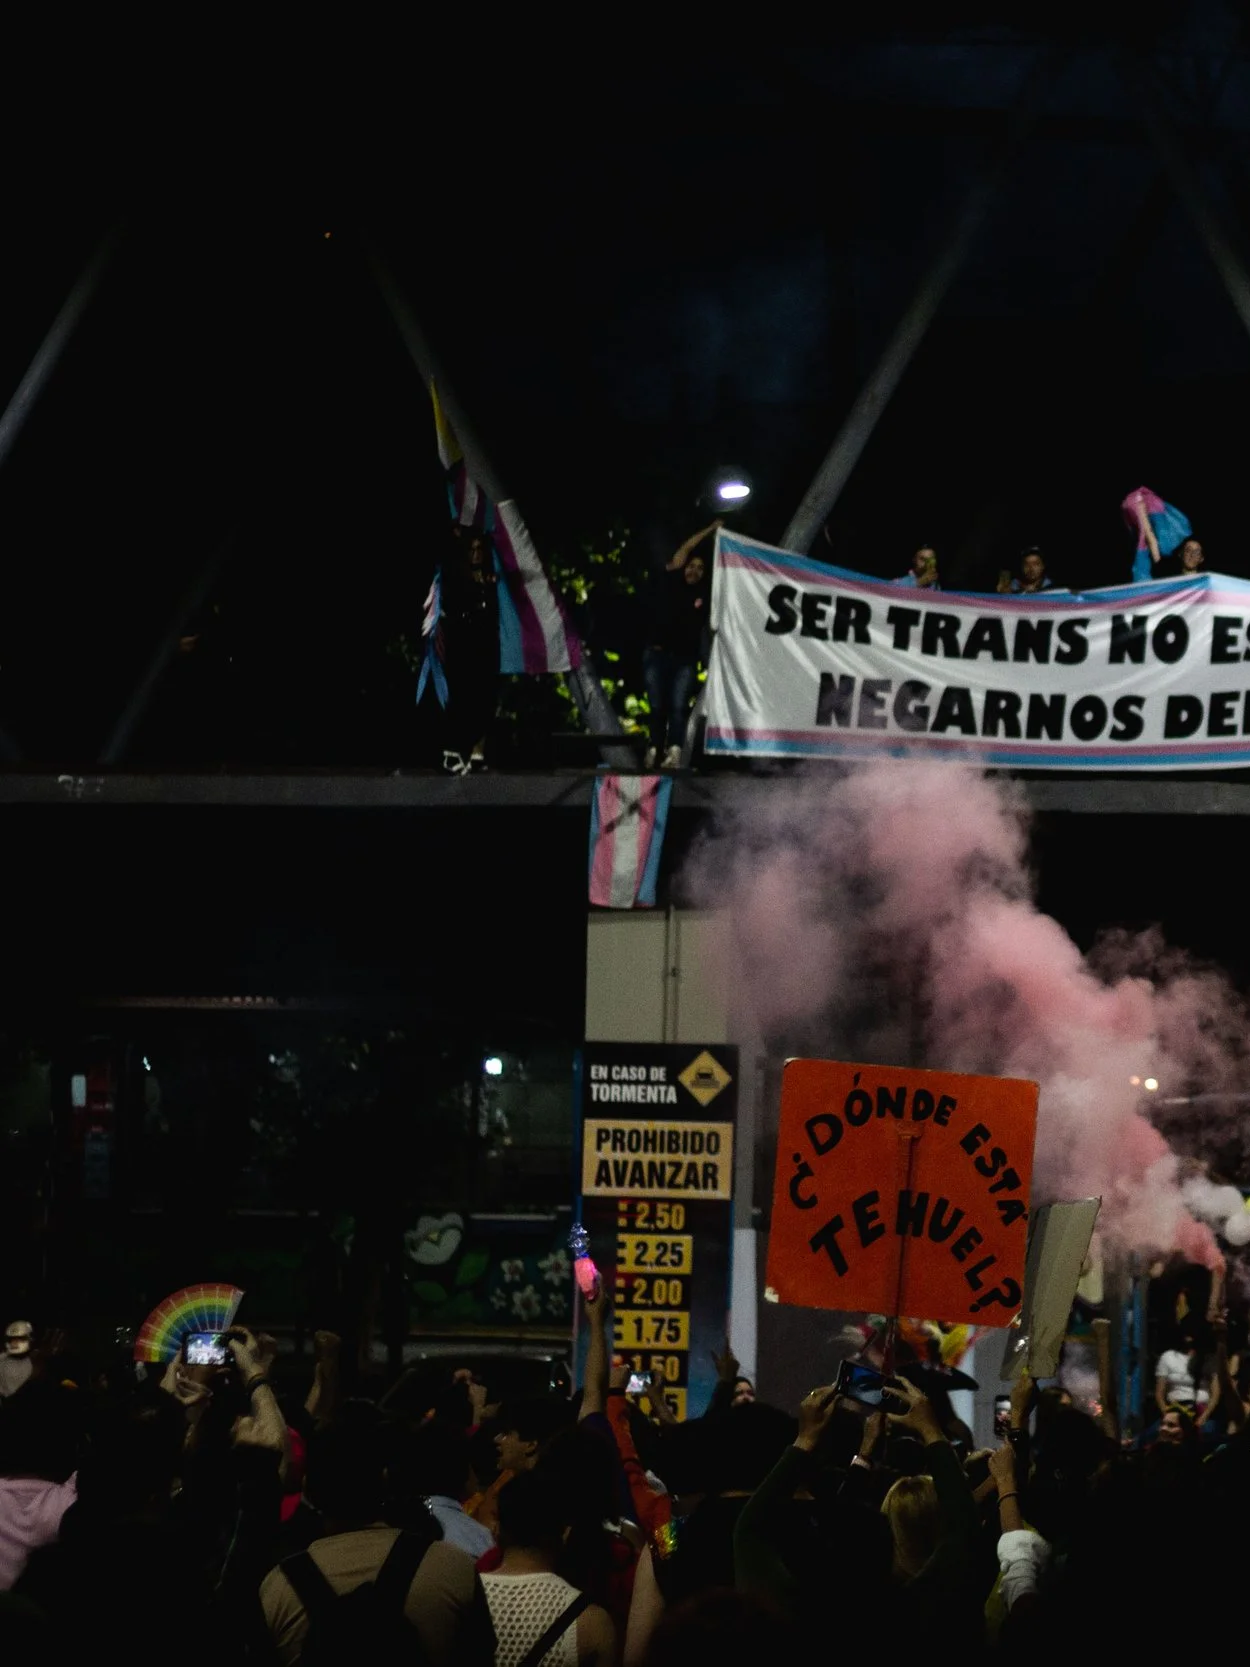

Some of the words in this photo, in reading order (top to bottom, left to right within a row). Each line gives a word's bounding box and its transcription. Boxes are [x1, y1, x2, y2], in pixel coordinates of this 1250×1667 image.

[765, 584, 871, 644] SER
[887, 606, 1091, 665] TRANS
[1108, 614, 1189, 664] NO
[815, 672, 1146, 741] NEGARNOS
[590, 1065, 608, 1081] EN
[611, 1066, 646, 1081] CASO
[650, 1067, 666, 1081] DE
[590, 1083, 677, 1103] TORMENTA
[596, 1128, 721, 1155] PROHIBIDO
[594, 1159, 719, 1190] AVANZAR
[809, 1190, 1022, 1313] TEHUEL?
